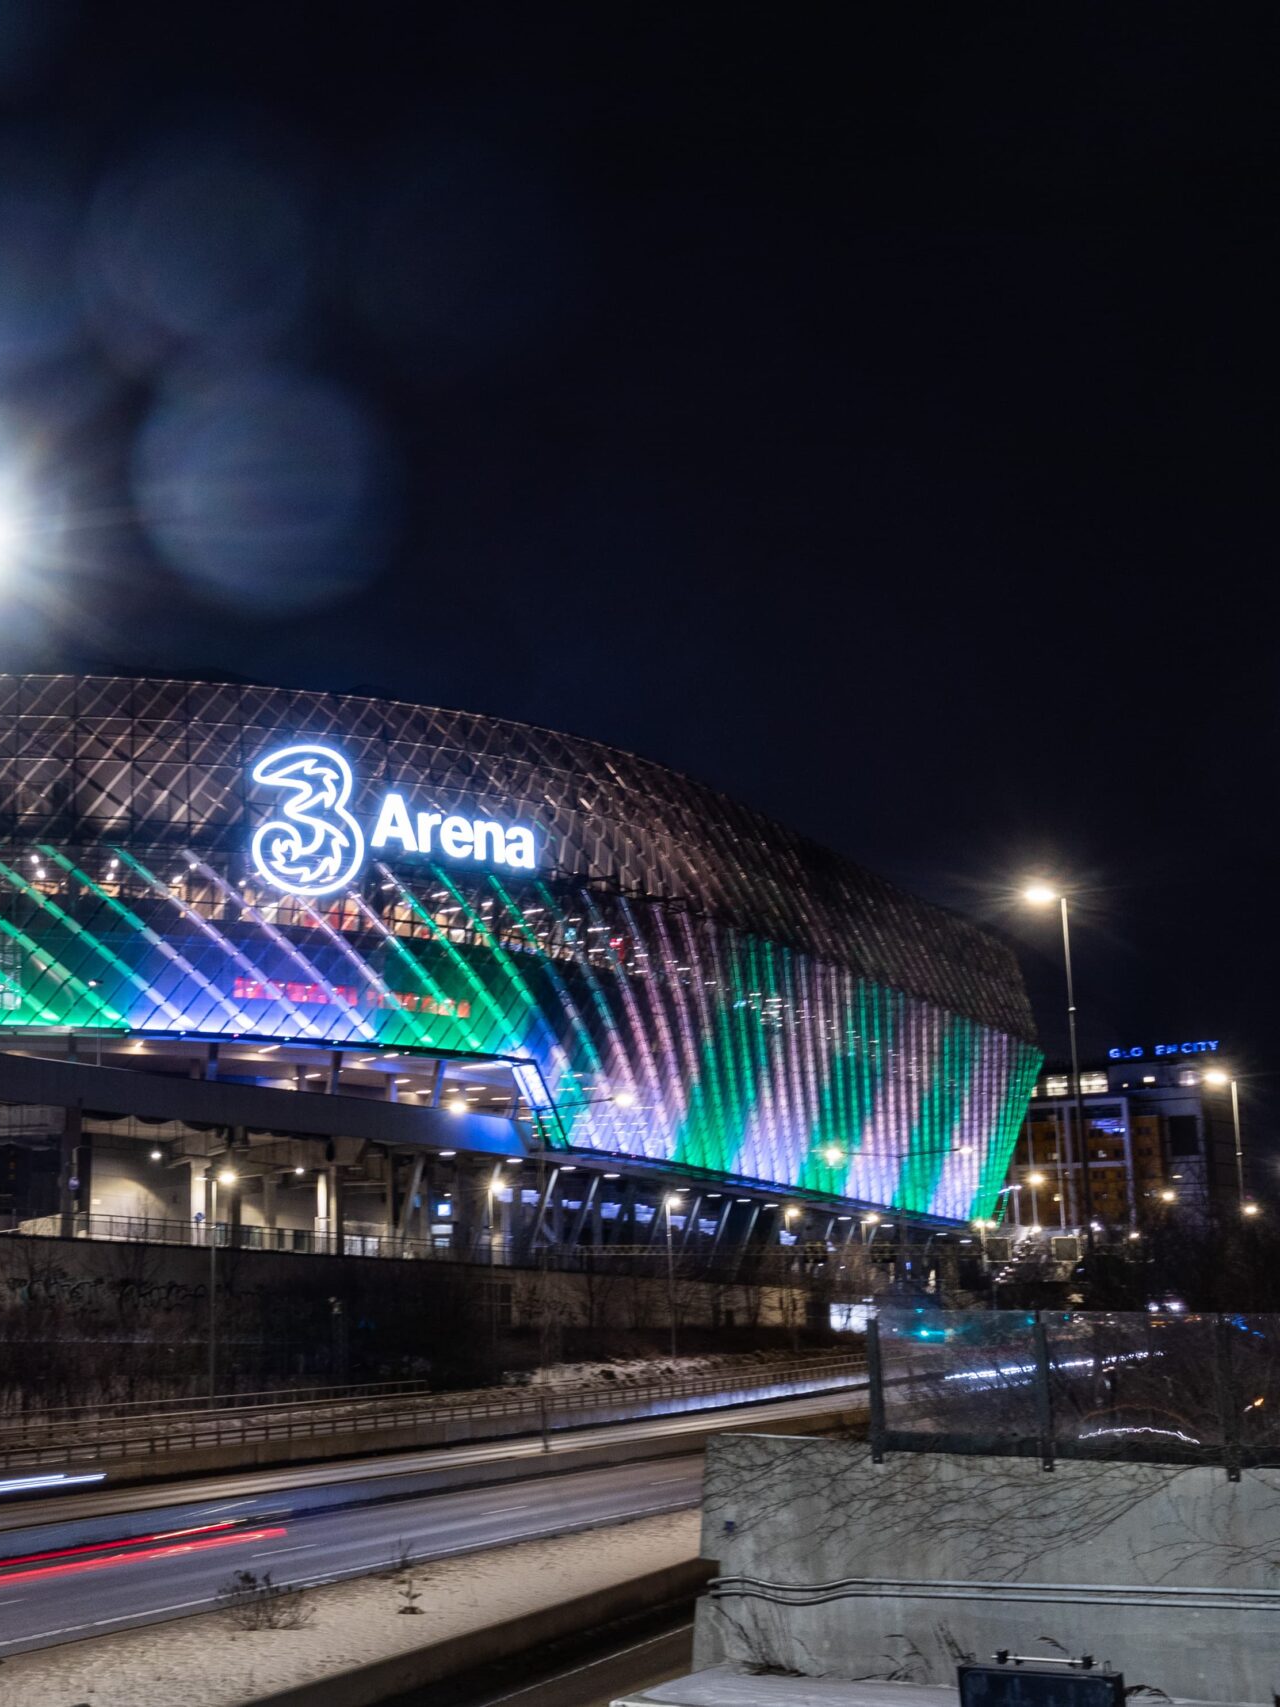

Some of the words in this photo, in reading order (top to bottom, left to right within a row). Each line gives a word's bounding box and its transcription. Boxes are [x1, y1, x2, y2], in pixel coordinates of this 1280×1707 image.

[251, 745, 365, 896] 3
[371, 794, 536, 869] Arena
[1181, 1040, 1219, 1054] CITY
